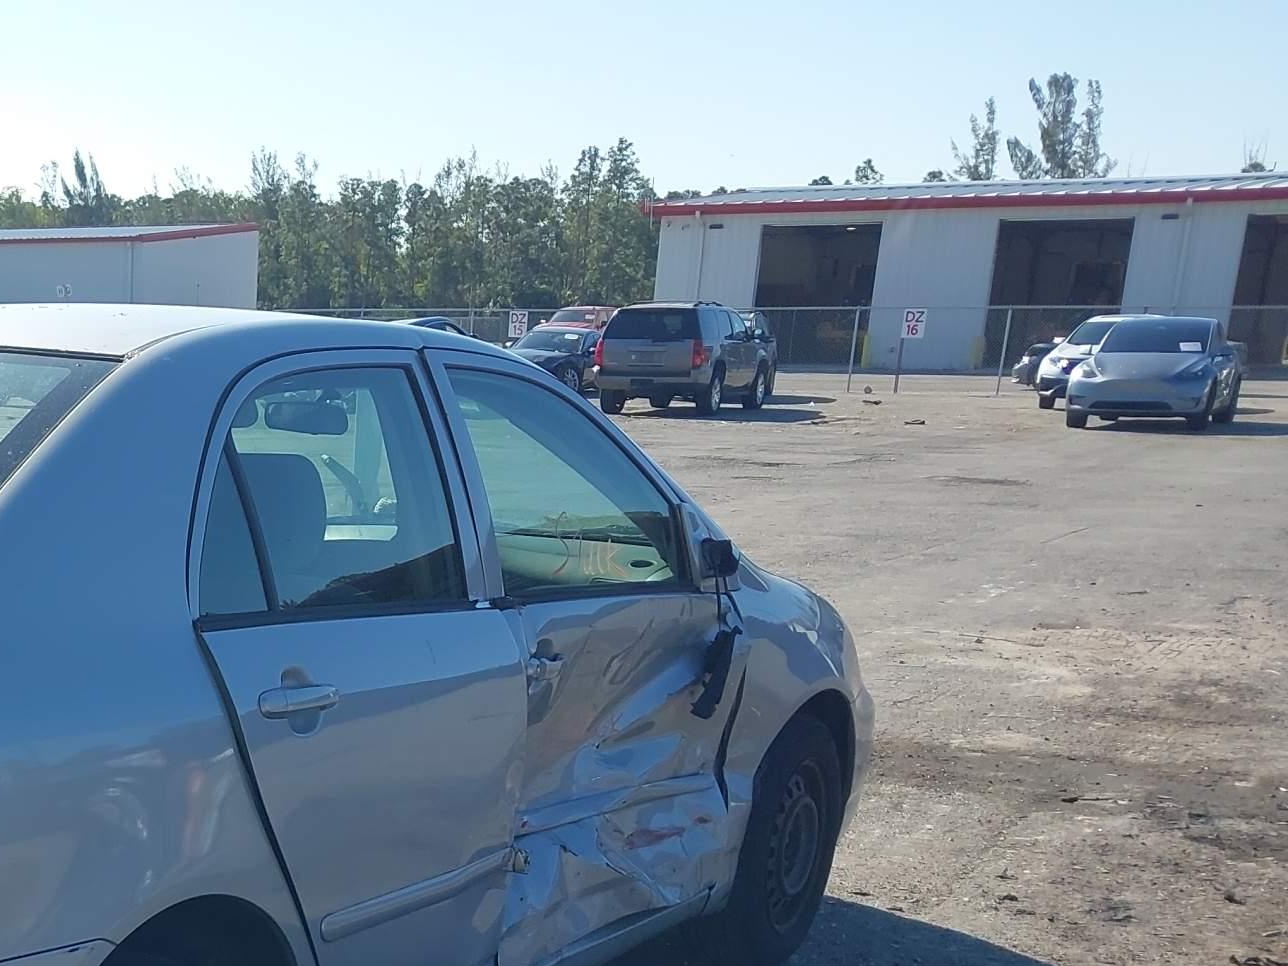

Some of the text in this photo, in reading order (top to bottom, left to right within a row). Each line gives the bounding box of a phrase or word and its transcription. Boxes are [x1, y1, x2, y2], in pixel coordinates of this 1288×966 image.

[511, 312, 526, 324] DZ
[905, 310, 925, 323] DZ
[513, 324, 523, 336] 15
[906, 323, 919, 336] 16
